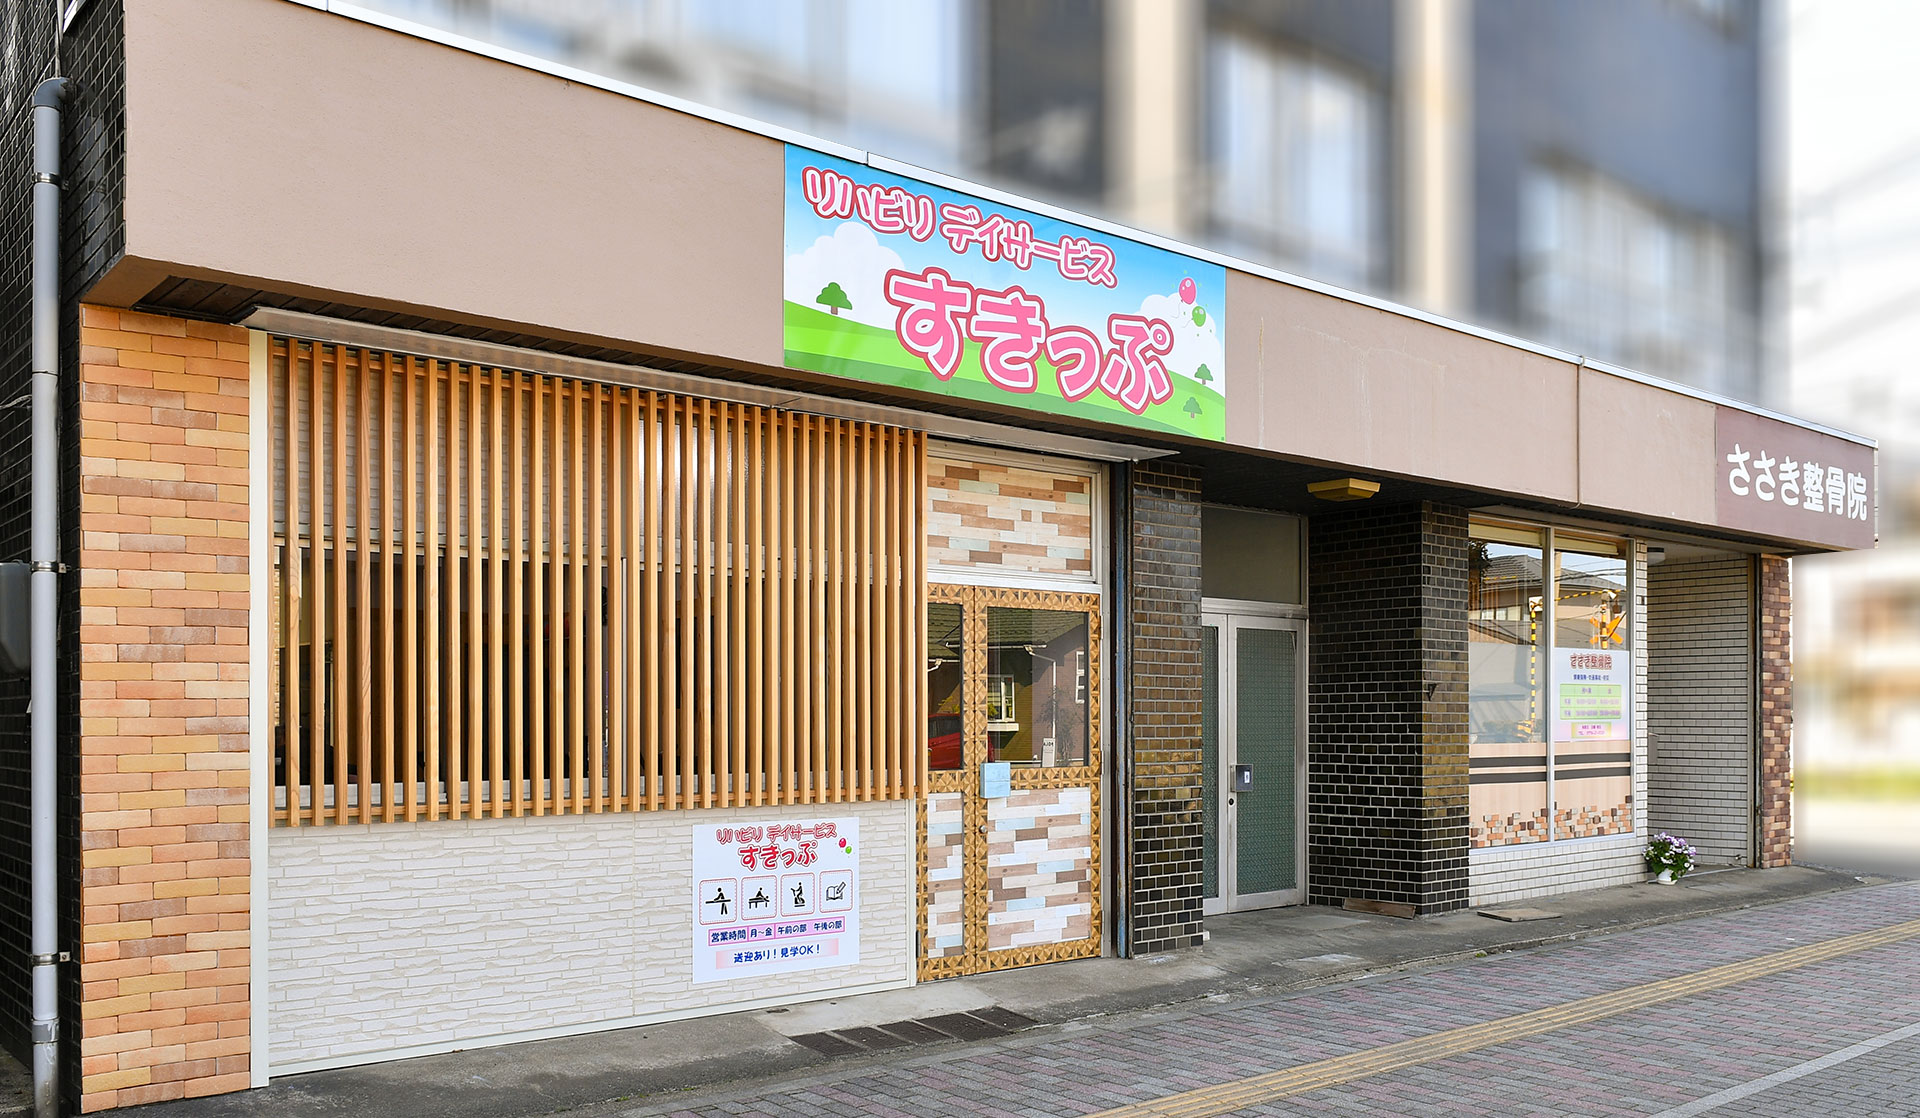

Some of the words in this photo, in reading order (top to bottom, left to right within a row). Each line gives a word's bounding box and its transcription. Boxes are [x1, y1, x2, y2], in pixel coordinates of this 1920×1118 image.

[802, 166, 936, 243] リハビリ
[939, 203, 1118, 289] デイサービス
[884, 267, 1175, 416] すきっぷ
[1727, 443, 1867, 521] ささき整骨院
[716, 826, 763, 845] リハビリ
[766, 823, 837, 842] デイサービス
[738, 841, 818, 871] すきっぷ
[711, 929, 746, 943] 営業時間
[777, 924, 807, 935] 午前の部
[813, 920, 843, 931] 午後の部
